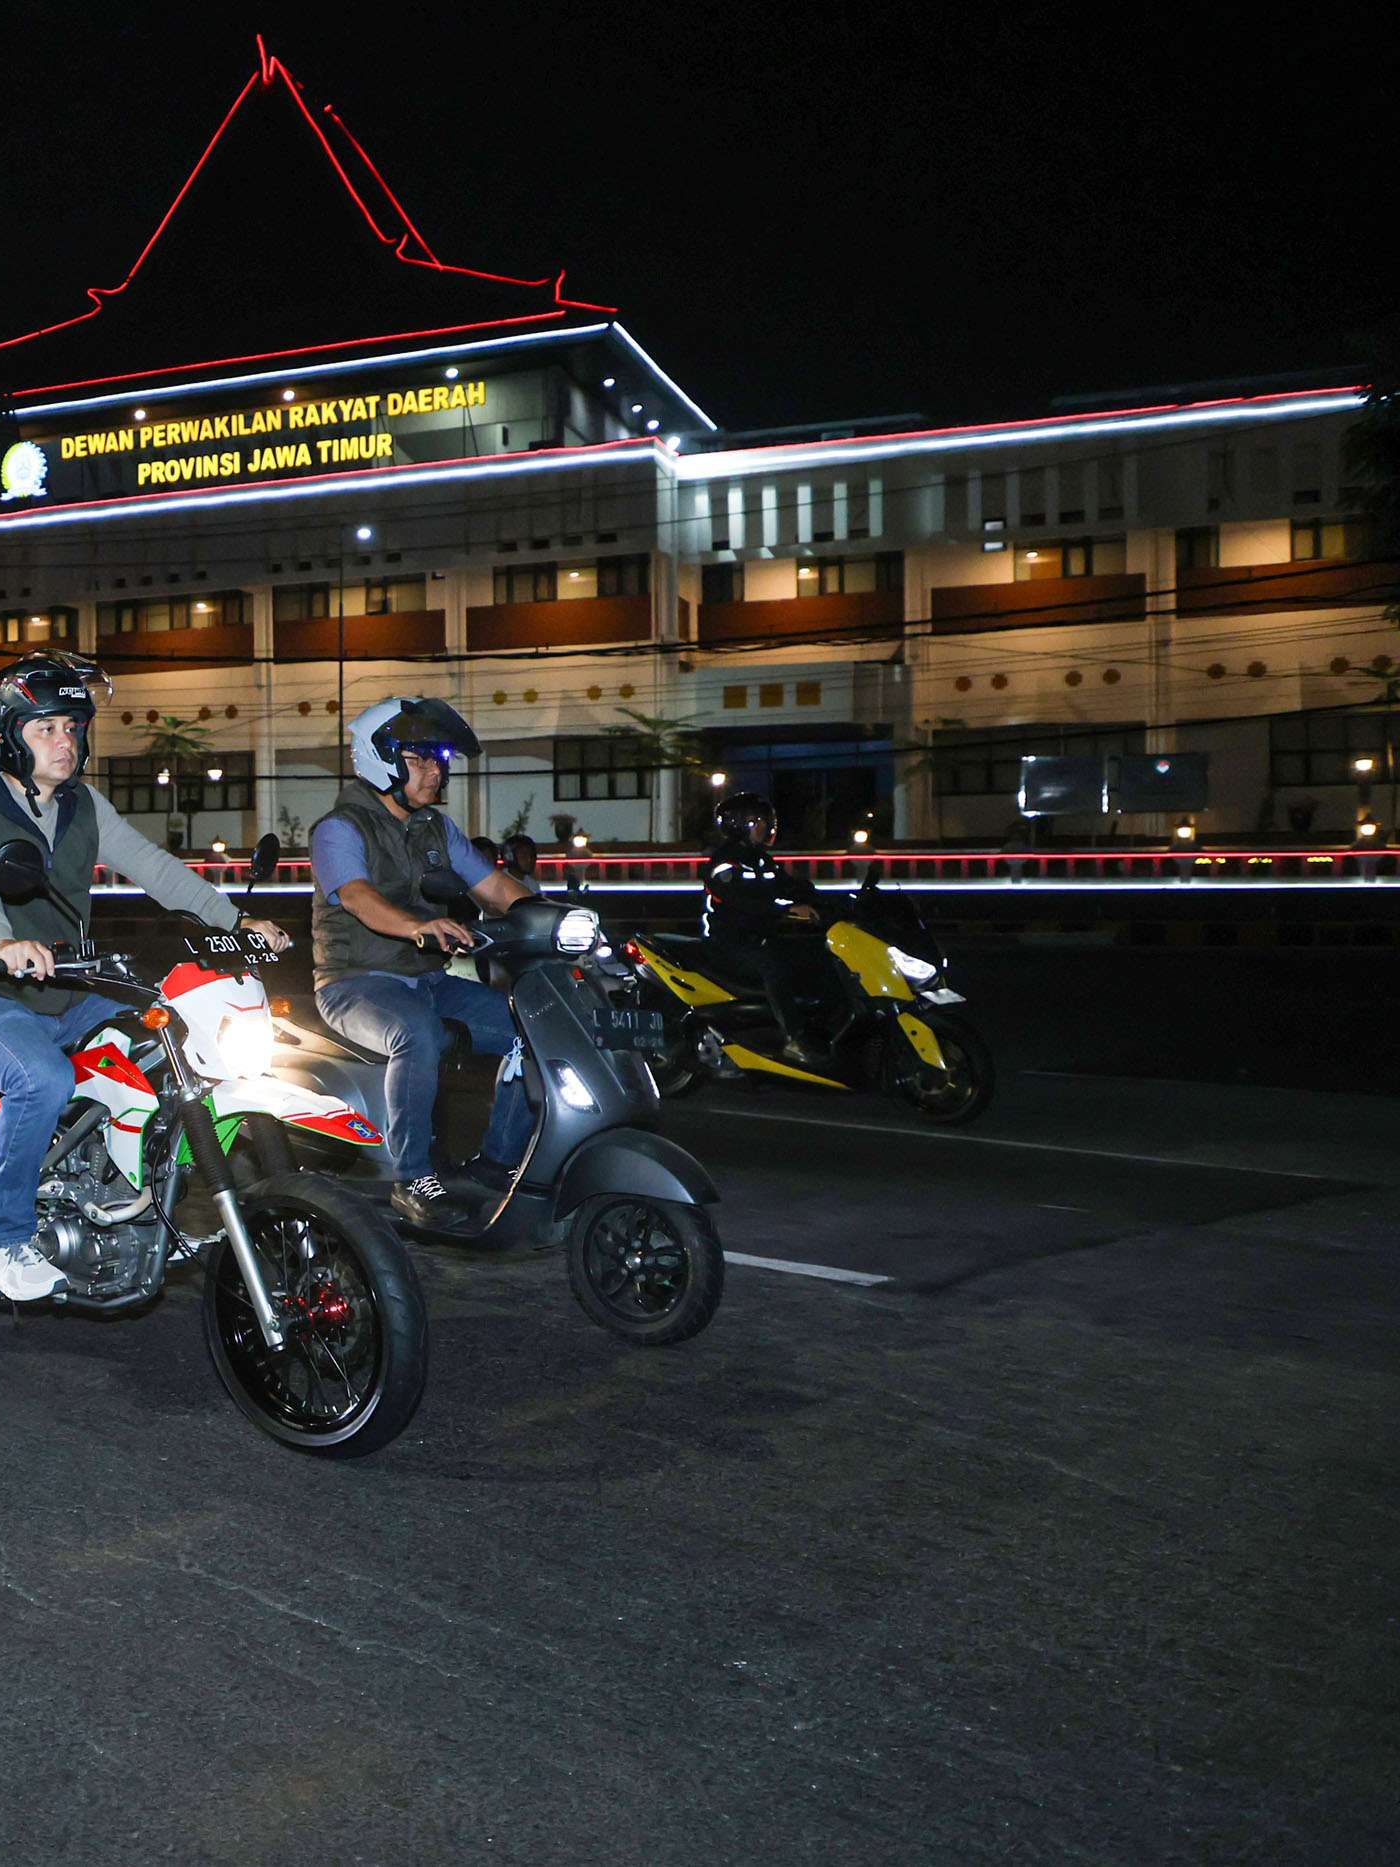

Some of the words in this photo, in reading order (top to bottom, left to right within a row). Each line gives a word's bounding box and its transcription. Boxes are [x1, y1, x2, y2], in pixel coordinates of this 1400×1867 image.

[61, 429, 134, 459] DEWAN
[140, 407, 282, 449] PERWAKILAN
[289, 395, 380, 429] RAKYAT
[387, 381, 486, 416] DAERAH
[137, 451, 241, 486] PROVINSI
[247, 443, 312, 472] JAWA
[316, 433, 393, 464] TIMUR
[184, 937, 199, 954] L
[204, 935, 241, 953] 2501
[247, 931, 266, 950] CP
[592, 1009, 601, 1028] L
